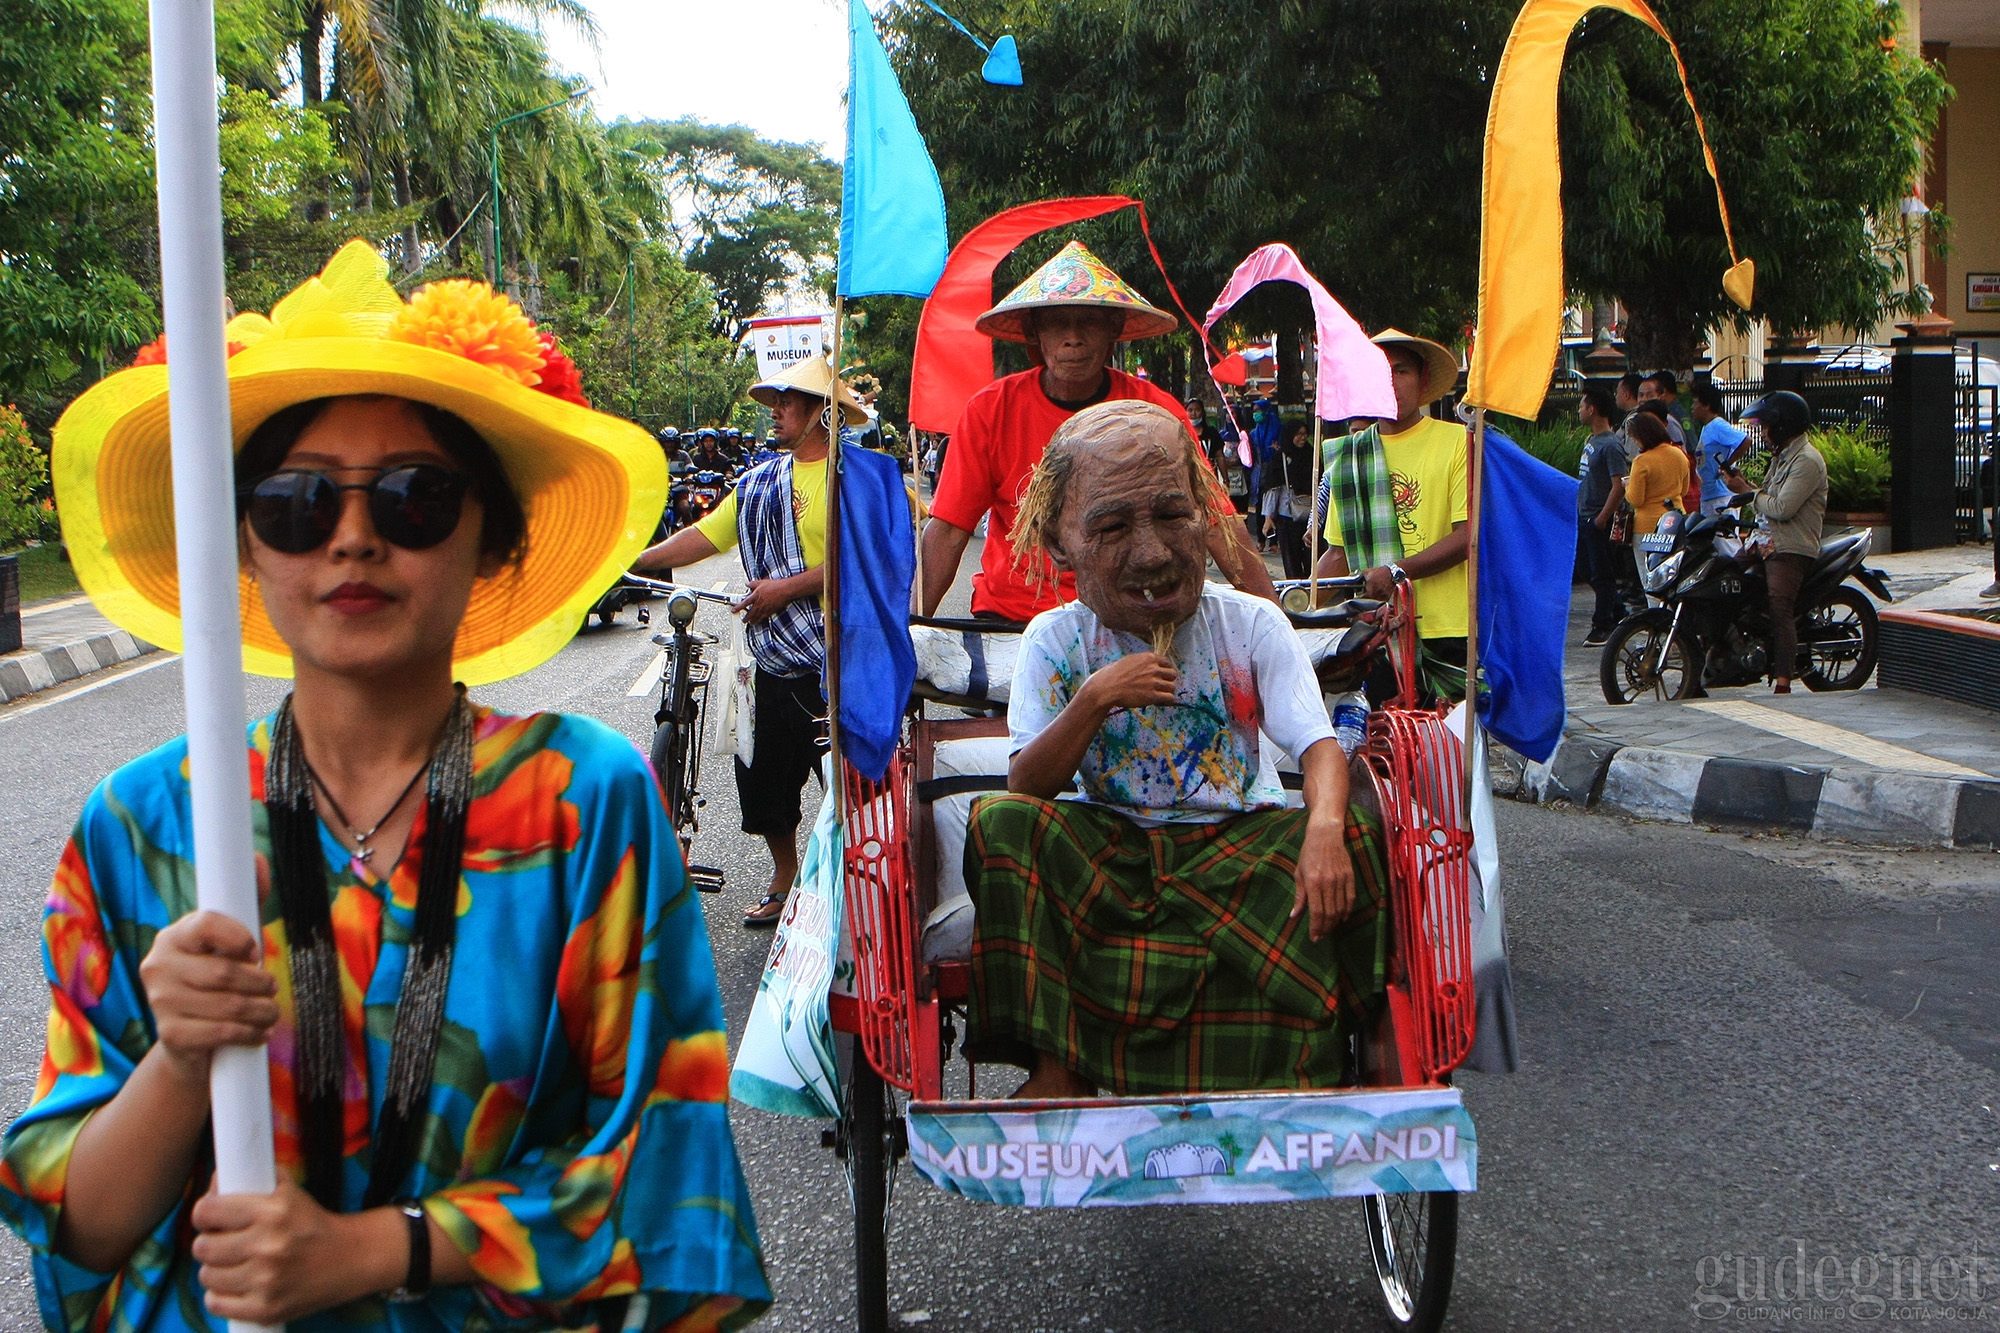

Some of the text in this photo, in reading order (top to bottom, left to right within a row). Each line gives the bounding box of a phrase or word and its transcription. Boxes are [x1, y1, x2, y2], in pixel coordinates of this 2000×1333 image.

[767, 349, 812, 361] MUSEUM
[926, 1124, 1458, 1180] MUSEUM AFFANDI
